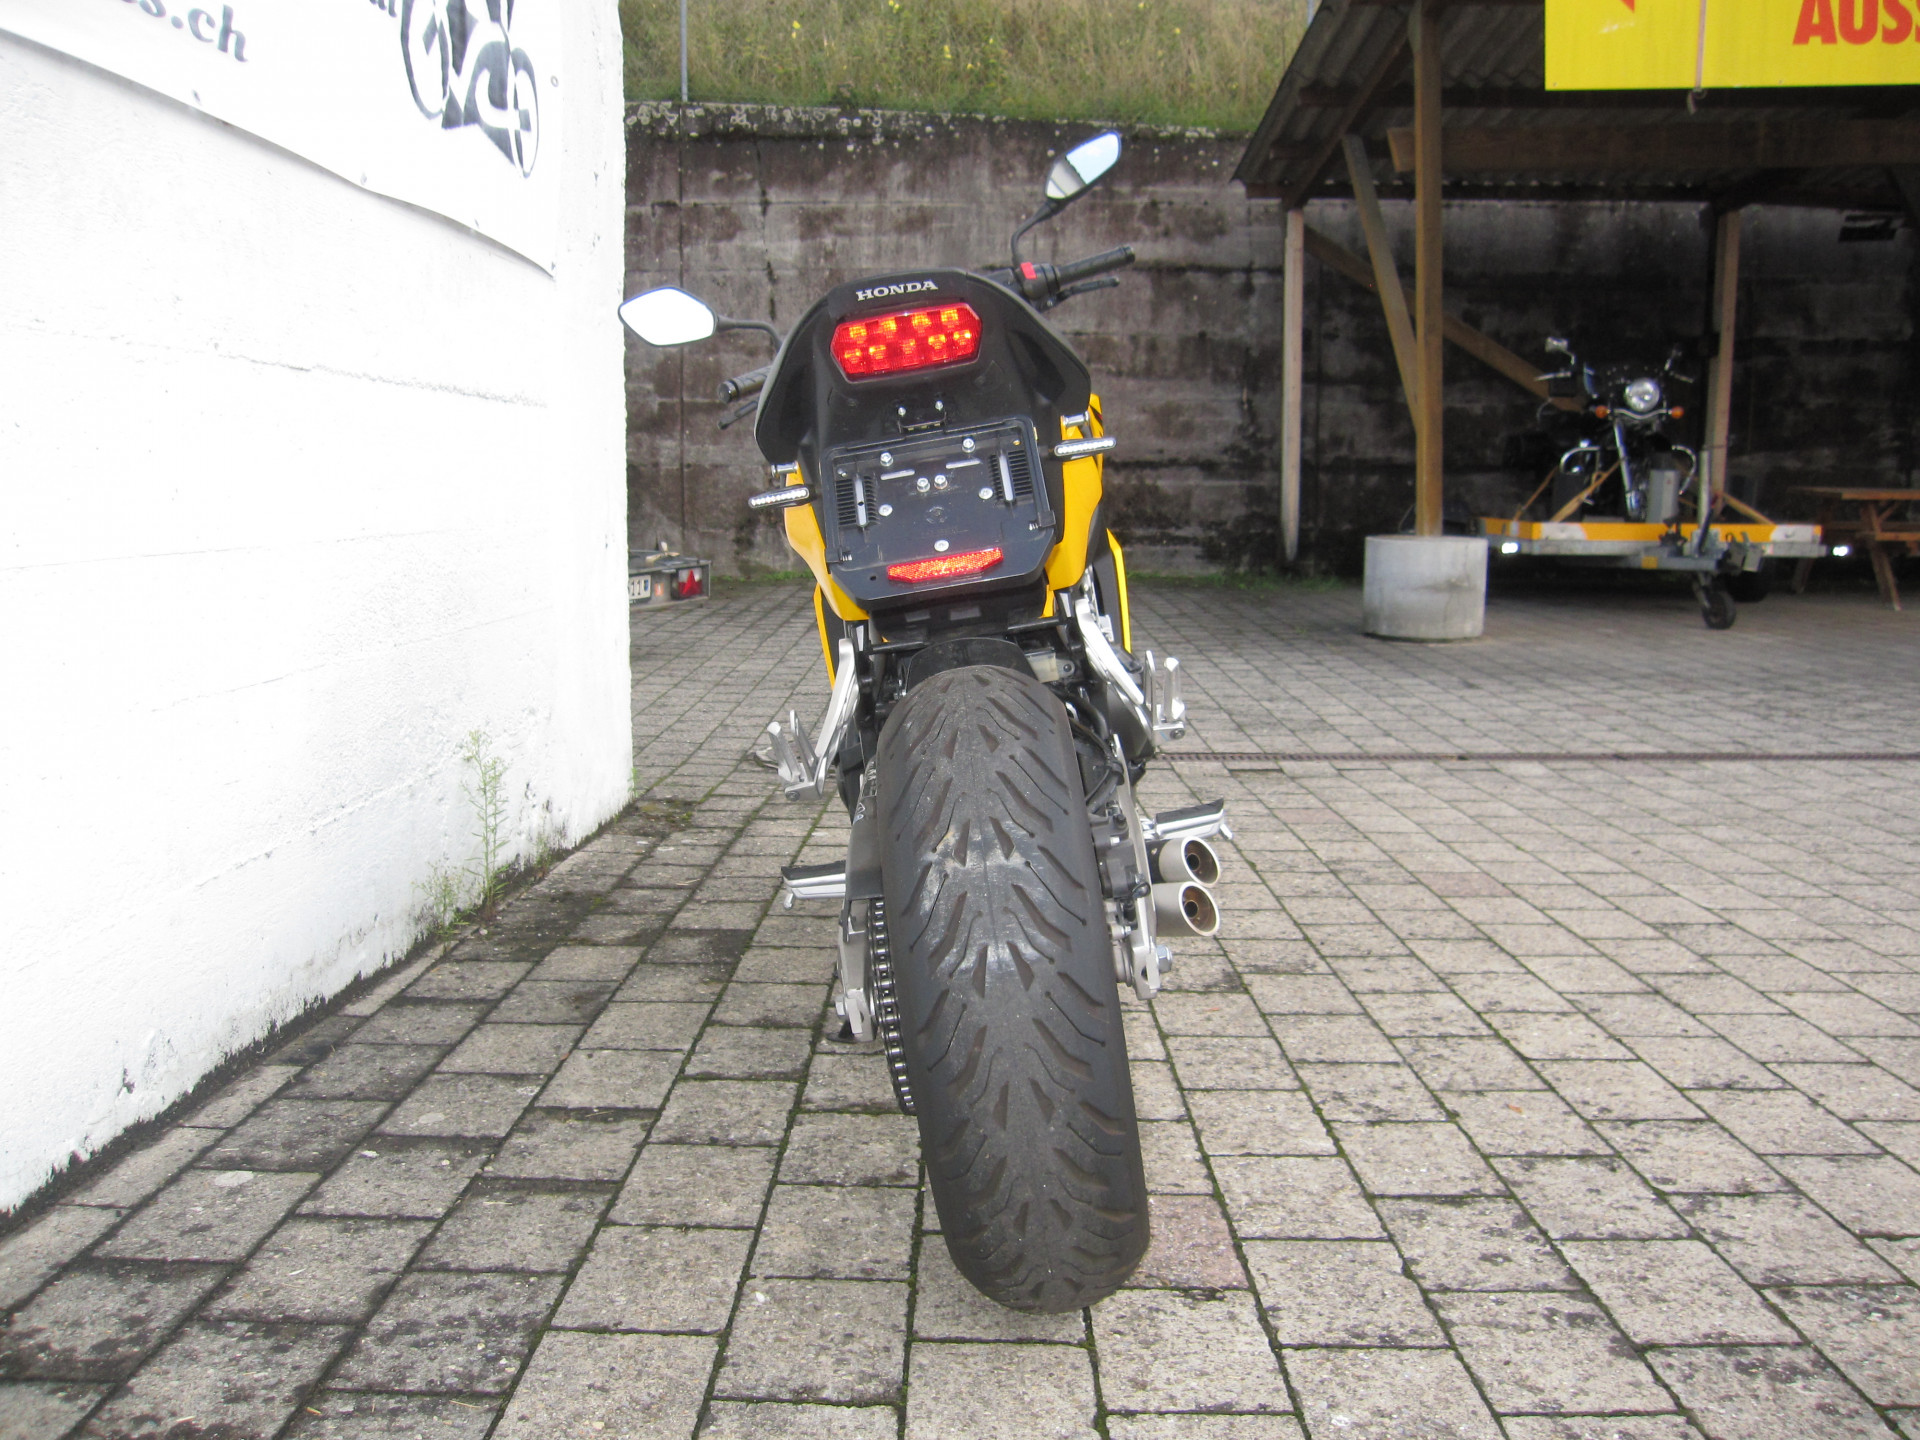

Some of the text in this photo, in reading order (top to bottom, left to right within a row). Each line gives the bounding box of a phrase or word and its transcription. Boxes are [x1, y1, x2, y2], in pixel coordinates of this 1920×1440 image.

[122, 0, 248, 62] s.ch
[1792, 0, 1920, 45] AUS
[855, 279, 939, 301] HONDA
